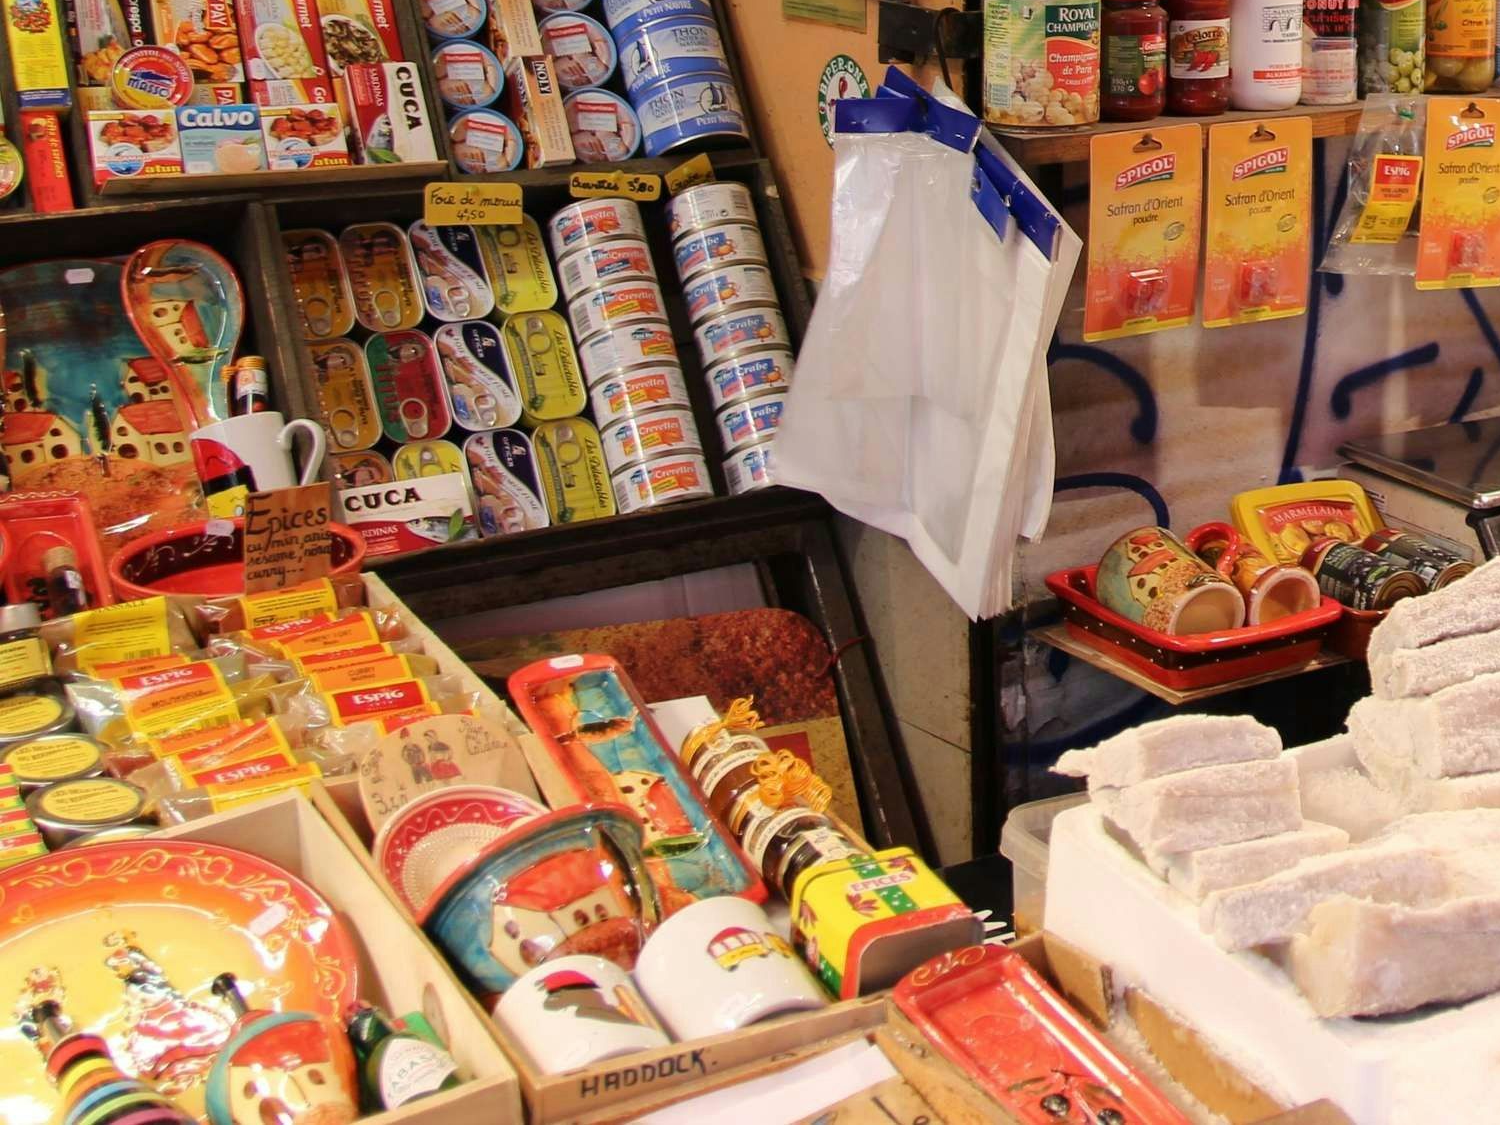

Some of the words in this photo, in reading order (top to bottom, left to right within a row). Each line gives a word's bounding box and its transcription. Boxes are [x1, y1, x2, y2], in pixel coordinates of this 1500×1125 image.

[1059, 7, 1096, 23] ROYAL
[532, 62, 551, 94] NOLY
[395, 65, 424, 131] CUCA
[179, 108, 256, 128] Calvo
[1446, 124, 1496, 151] SPIGOL
[1114, 153, 1176, 191] SPIGOL
[1232, 147, 1289, 182] SPIGOL
[1437, 162, 1467, 176] Safran
[459, 195, 476, 205] de
[1106, 200, 1141, 218] Safran
[1142, 194, 1185, 212] d'Orient
[1224, 191, 1257, 208] Safran
[1258, 188, 1296, 204] d'Orient
[726, 317, 761, 332] Crabe
[736, 361, 768, 376] Crabe
[343, 486, 423, 513] CUCA
[1272, 504, 1346, 526] MARMELADA
[360, 524, 400, 539] RDINAS
[141, 667, 193, 687] ESPIG
[351, 689, 405, 706] ESPIG
[214, 761, 271, 783] ESPIG
[850, 871, 913, 893] EPICES
